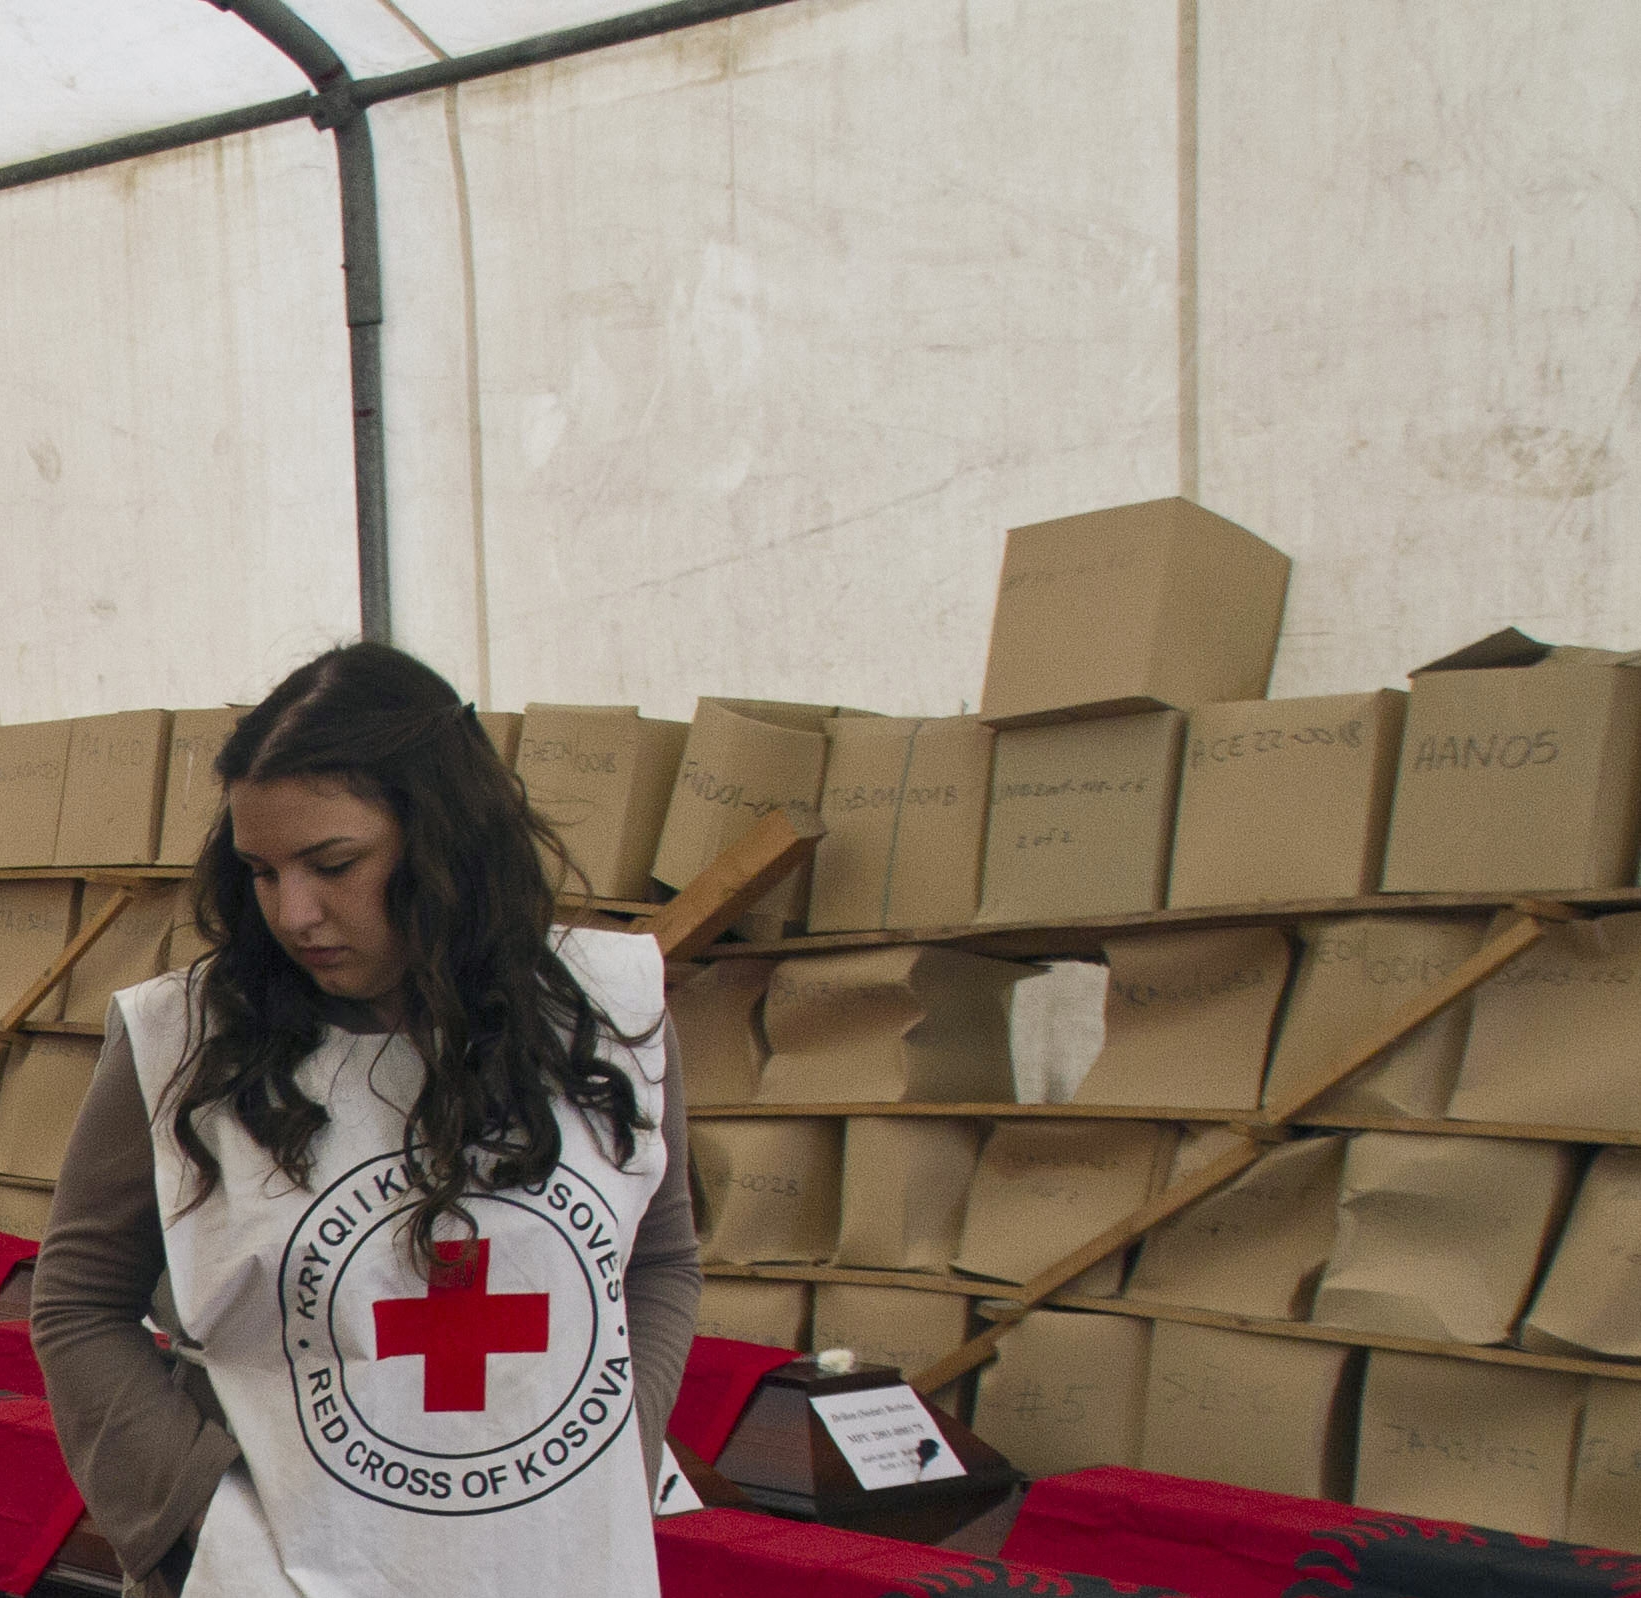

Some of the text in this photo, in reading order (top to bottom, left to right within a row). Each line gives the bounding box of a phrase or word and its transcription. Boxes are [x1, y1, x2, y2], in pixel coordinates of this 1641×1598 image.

[297, 1205, 357, 1320] KRYQI
[308, 1355, 632, 1500] RED CROSS OF KOSOVA
